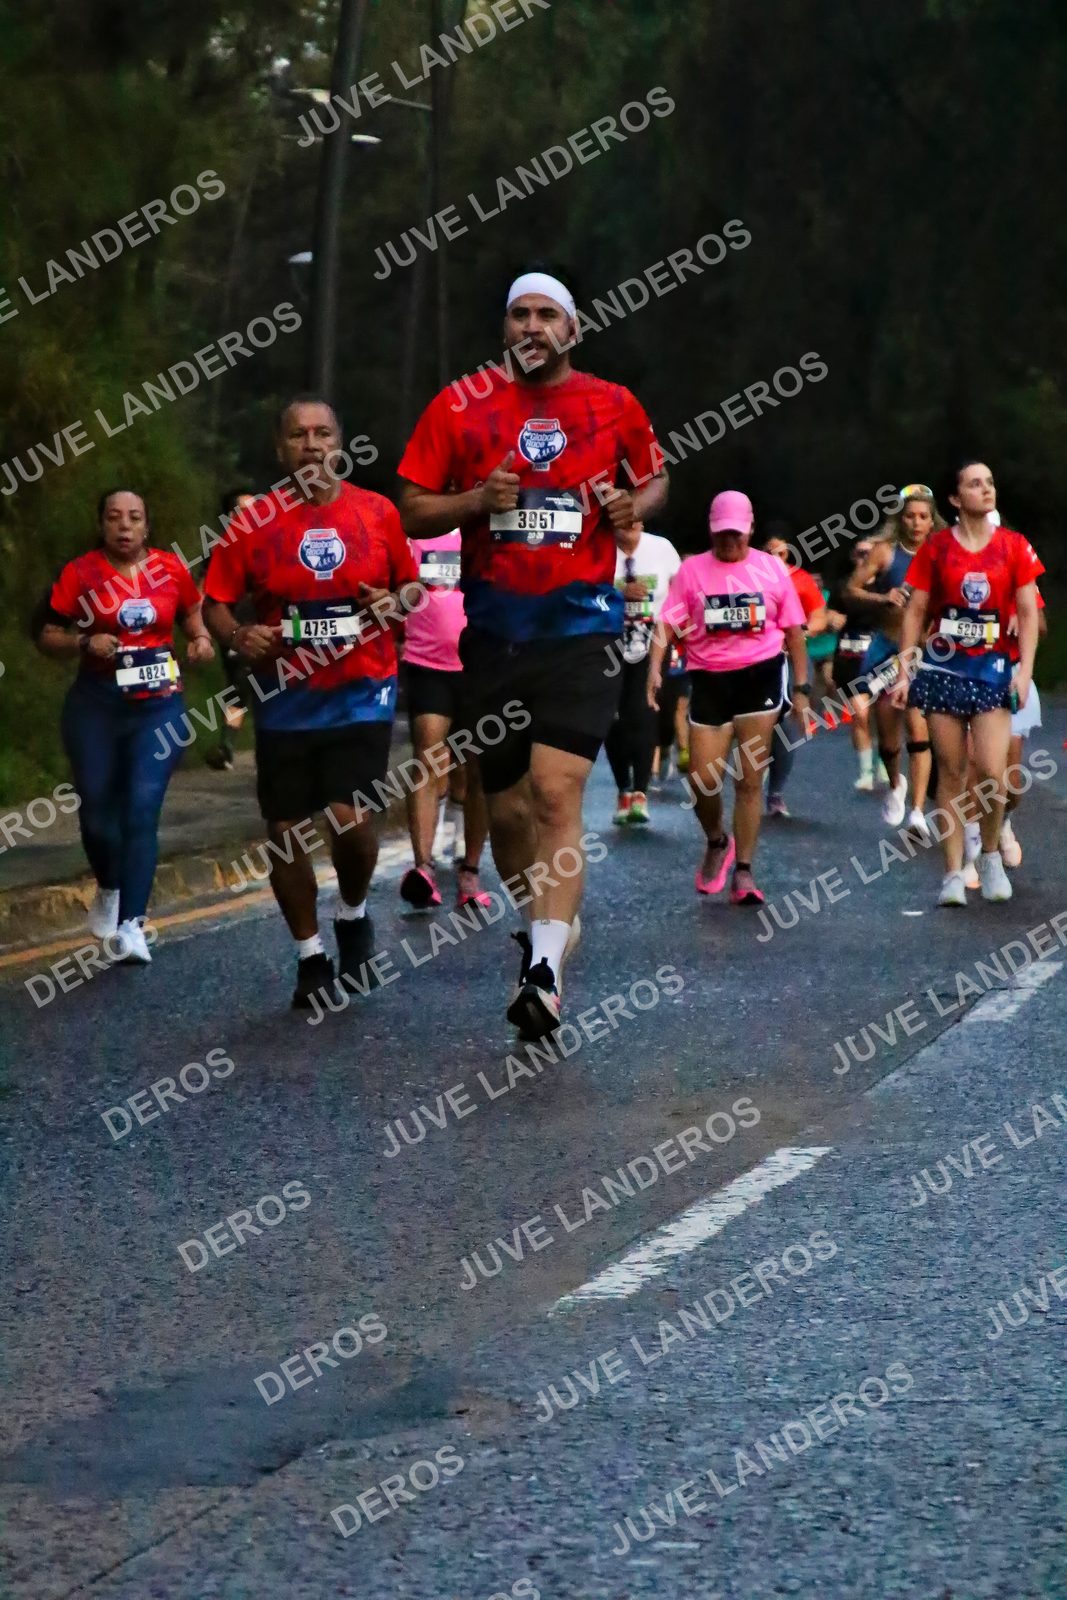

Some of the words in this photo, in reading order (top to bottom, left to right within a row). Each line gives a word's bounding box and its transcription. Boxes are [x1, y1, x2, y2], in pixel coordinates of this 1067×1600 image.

[518, 511, 555, 529] 3951
[723, 608, 749, 621] 4263
[304, 619, 338, 636] 4735
[138, 664, 166, 681] 4824
